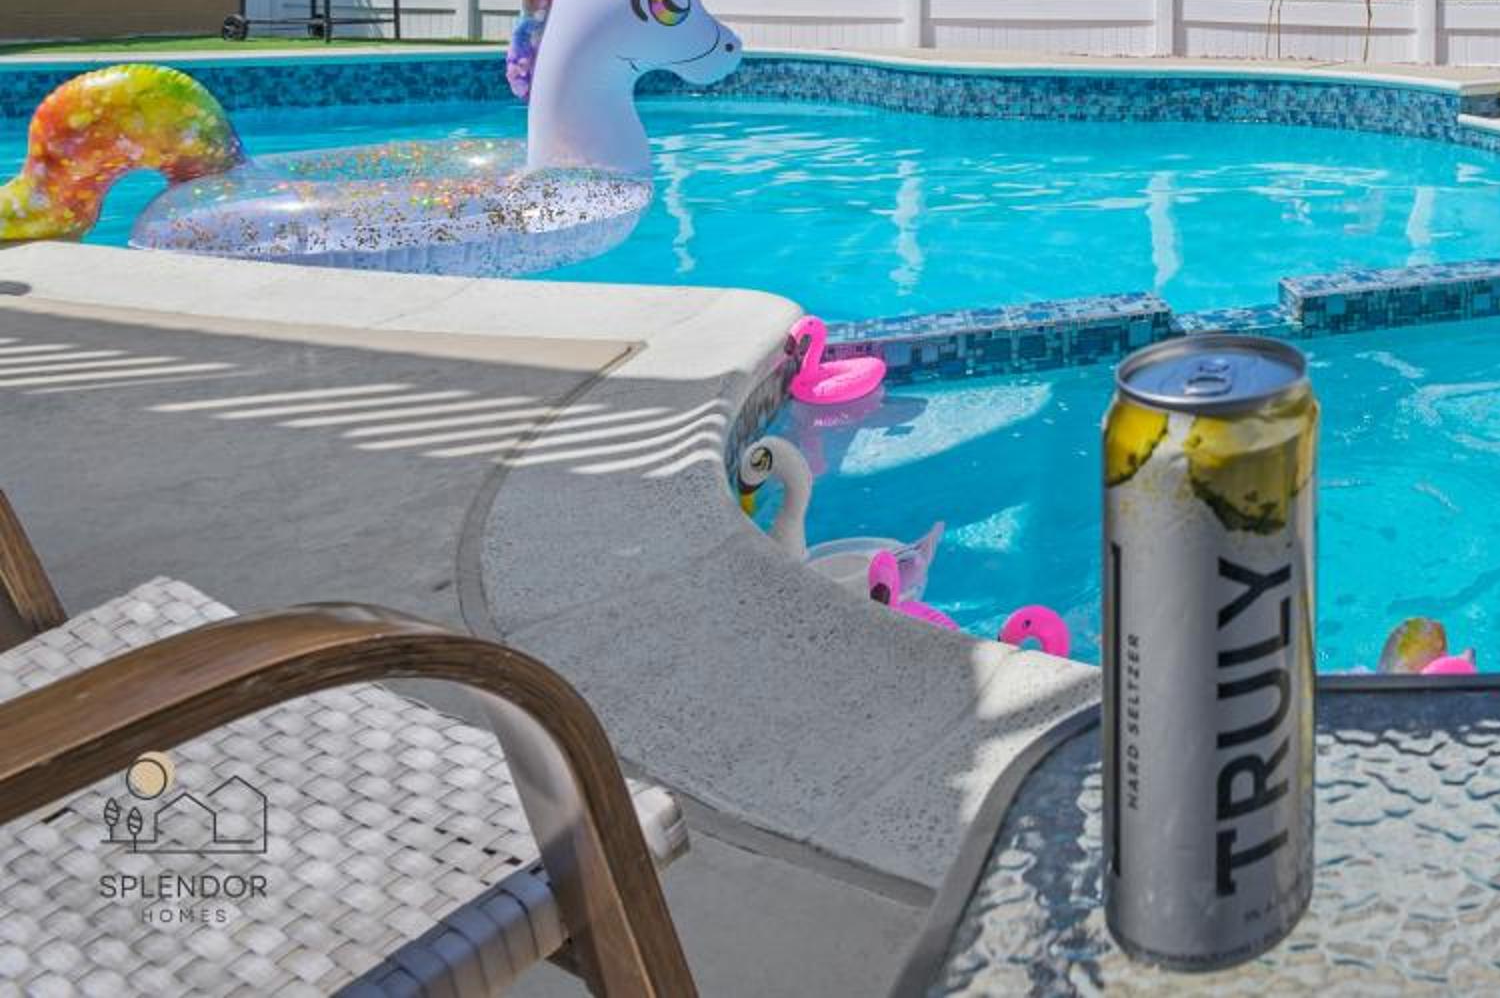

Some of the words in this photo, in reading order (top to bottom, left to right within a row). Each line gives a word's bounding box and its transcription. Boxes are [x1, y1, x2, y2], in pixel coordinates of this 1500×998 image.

[1127, 634, 1140, 734] SELTZER
[1216, 557, 1292, 896] TRULY
[1127, 745, 1139, 810] HARD
